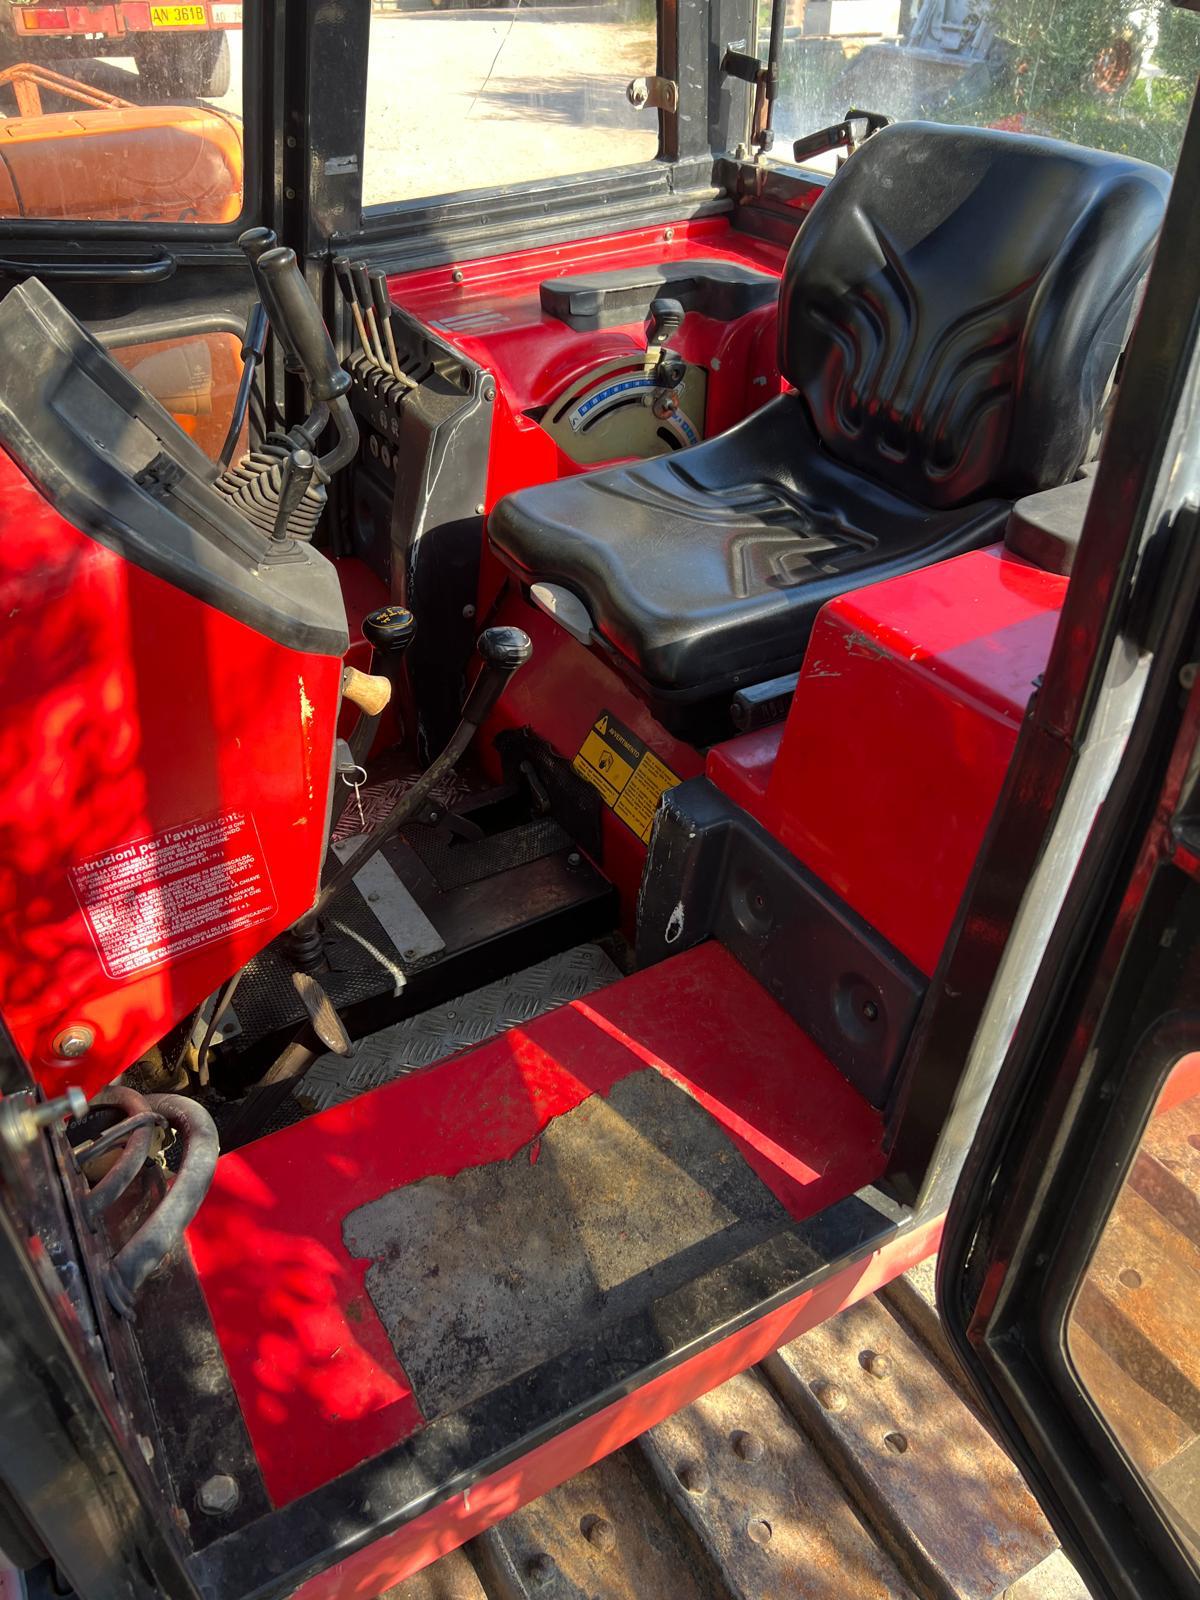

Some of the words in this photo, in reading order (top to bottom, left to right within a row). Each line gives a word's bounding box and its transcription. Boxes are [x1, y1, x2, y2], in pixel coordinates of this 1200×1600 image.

[608, 727, 640, 759] AVVERTIMENTO
[71, 846, 136, 875] Istruzioni
[138, 840, 163, 855] per
[107, 860, 129, 871] CHIAVE
[130, 853, 149, 863] NELLA
[149, 842, 180, 856] POSIZIONE
[148, 849, 175, 862] MOTORE
[187, 837, 210, 848] SPINTO
[175, 846, 199, 858] PEDALE
[103, 875, 135, 890] NORMALE
[142, 868, 156, 877] CON
[157, 858, 184, 871] MOTORE
[118, 879, 142, 892] CHIAVE
[142, 872, 163, 883] NELLA
[163, 860, 197, 876] POSIZIONE
[172, 885, 192, 895] NELLA
[193, 873, 225, 888] POSIZIONE
[229, 864, 247, 874] START
[188, 876, 201, 884] PER
[210, 863, 237, 877] SECONDI
[237, 857, 254, 866] DOPO
[86, 899, 107, 910] CLIMA
[108, 890, 135, 903] FREDDO
[88, 903, 113, 915] GIRARE
[122, 891, 146, 903] CHIAVE
[146, 884, 167, 894] NELLA
[167, 871, 201, 887] POSIZIONE
[110, 909, 139, 923] MOTORE
[154, 896, 173, 907] PARTE
[174, 888, 196, 899] ENTRO
[204, 875, 231, 888] SECONDI
[164, 898, 184, 908] NELLA
[185, 885, 217, 900] POSIZIONE
[184, 894, 206, 905] NUOVO
[207, 885, 229, 897] GIRARE
[238, 874, 260, 885] CHIAVE
[228, 895, 243, 904] FINO
[248, 888, 261, 896] CHE
[101, 933, 128, 946] QUANDO
[136, 920, 163, 933] MOTORE
[170, 907, 196, 920] AVVIATO
[196, 897, 224, 910] PORTARE
[233, 885, 254, 897] CHIAVE
[99, 932, 119, 942] NELLA
[106, 948, 130, 960] GIRARE
[162, 927, 184, 938] CHIAVE
[184, 919, 204, 930] NELLA
[204, 906, 236, 922] POSIZIONE
[111, 939, 138, 953] MOTORE
[158, 943, 186, 957] MANUALE
[187, 938, 200, 946] USO
